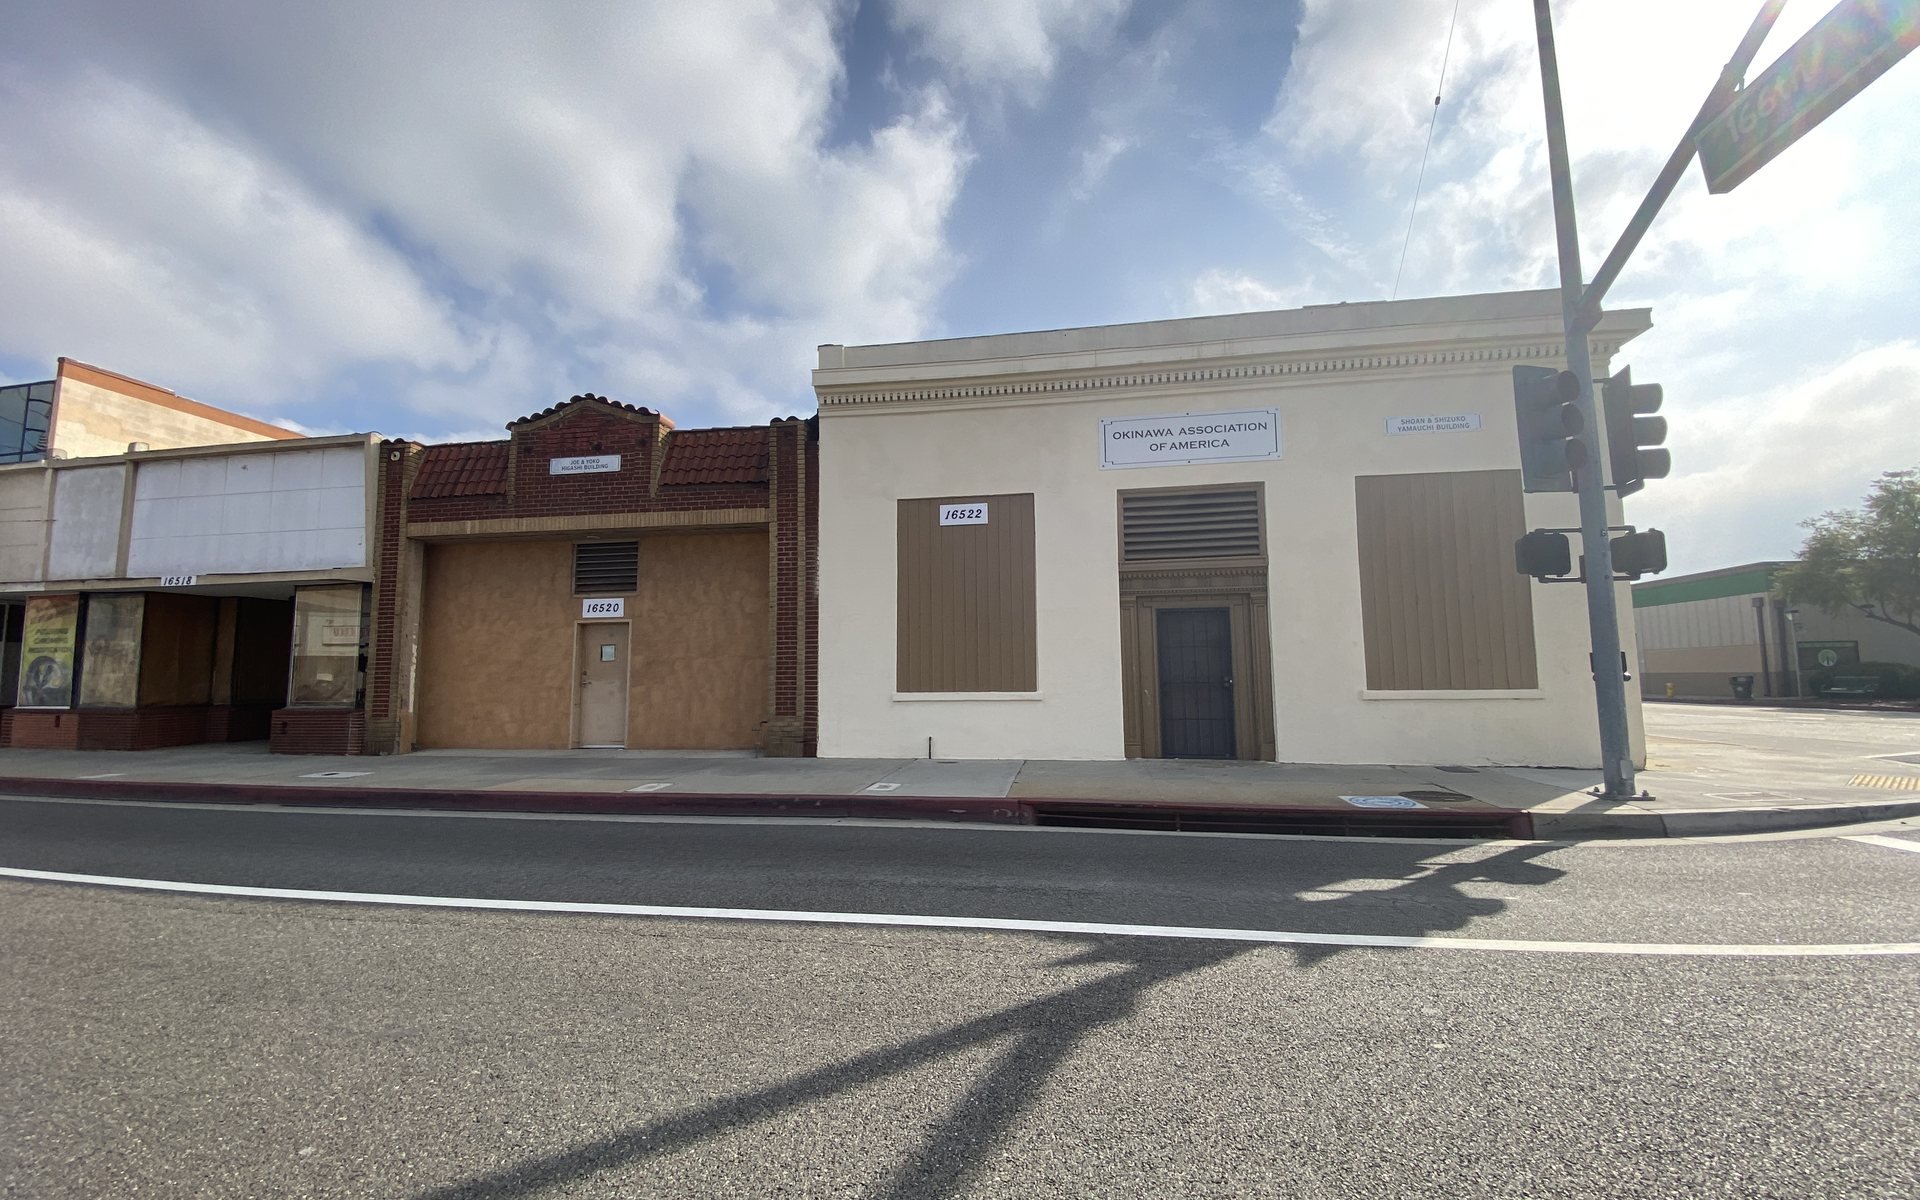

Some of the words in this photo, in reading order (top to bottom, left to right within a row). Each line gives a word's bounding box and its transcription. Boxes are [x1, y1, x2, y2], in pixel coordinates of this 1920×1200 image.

[1112, 428, 1173, 440] OKINAWA
[1178, 422, 1268, 436] ASSOCIATION
[1397, 424, 1434, 432] YAMAUCHI
[1436, 422, 1470, 430] BUILDING
[1149, 443, 1167, 452] OF
[1169, 439, 1230, 451] AMERICA
[945, 509, 982, 520] 16522
[163, 575, 193, 586] 16518
[587, 603, 619, 613] 16520
